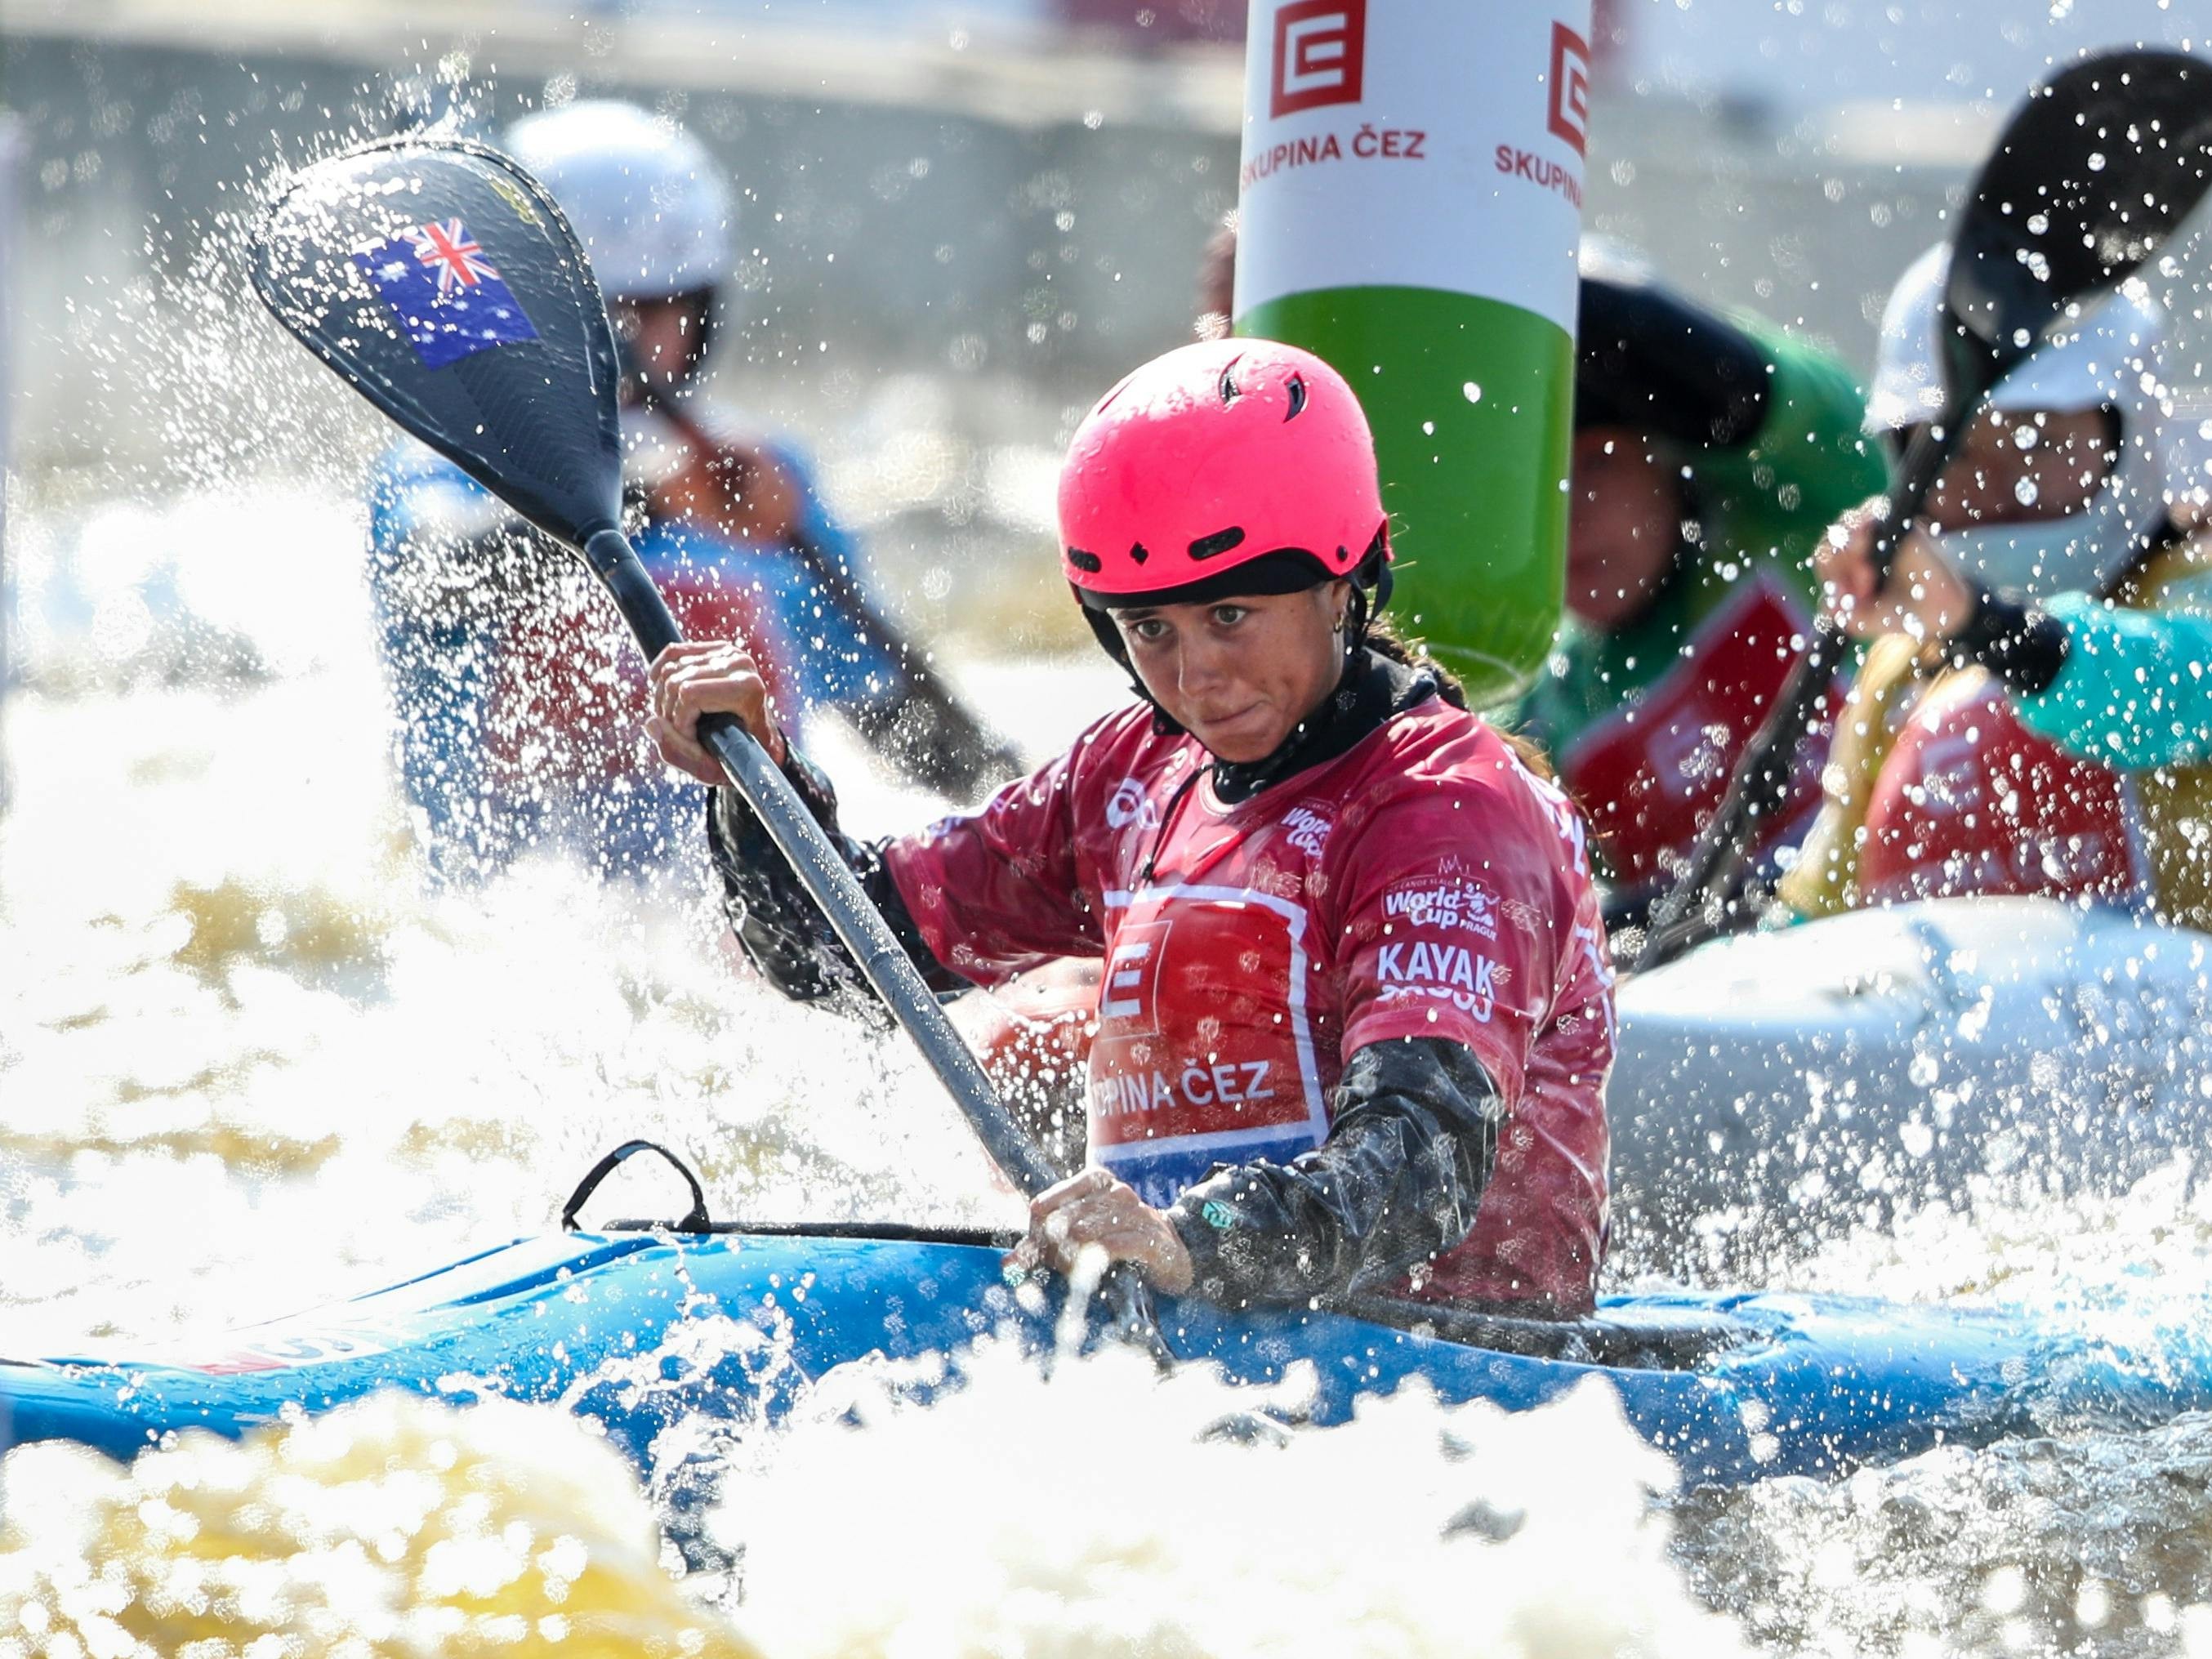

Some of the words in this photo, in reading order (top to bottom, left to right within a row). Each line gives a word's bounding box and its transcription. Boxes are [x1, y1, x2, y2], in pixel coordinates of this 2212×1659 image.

[1352, 123, 1426, 159] ČEZ
[1385, 885, 1461, 916] World
[1409, 907, 1459, 930] Cup
[1459, 919, 1497, 943] PRAGUE
[1377, 941, 1496, 1001] KAYAK
[1180, 1058, 1276, 1105] ČEZ
